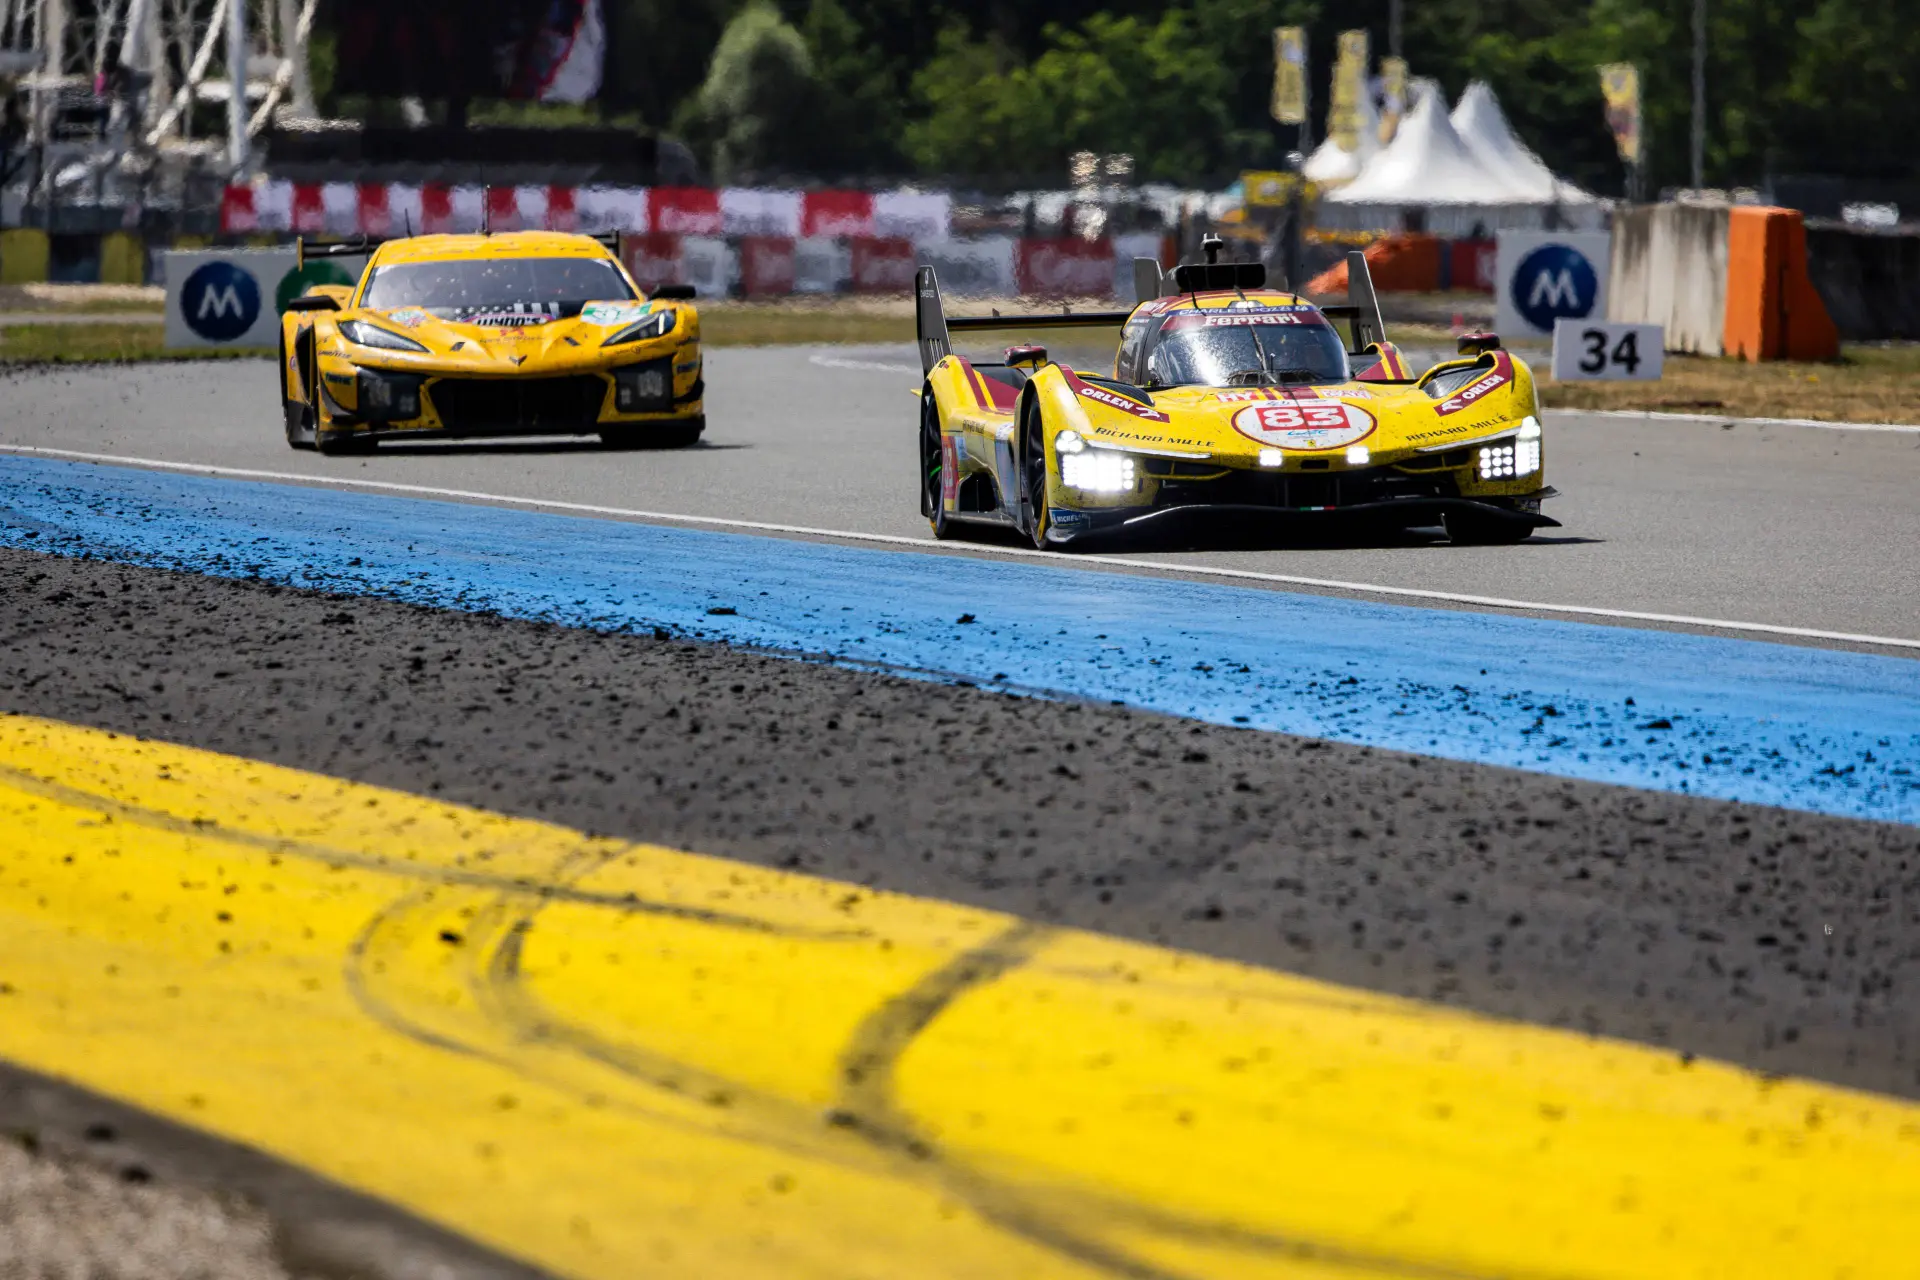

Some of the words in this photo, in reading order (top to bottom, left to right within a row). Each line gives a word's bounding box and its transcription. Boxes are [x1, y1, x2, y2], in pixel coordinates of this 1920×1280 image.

[1203, 313, 1302, 325] Ferrari
[1579, 328, 1641, 374] 34
[1462, 374, 1505, 399] ORLEN
[1081, 388, 1135, 410] ORLEN
[1263, 407, 1344, 427] 83
[1406, 425, 1468, 441] RICHARD
[1470, 414, 1509, 430] MILLE
[1095, 427, 1163, 442] RICHARD
[1167, 437, 1216, 448] MILLE
